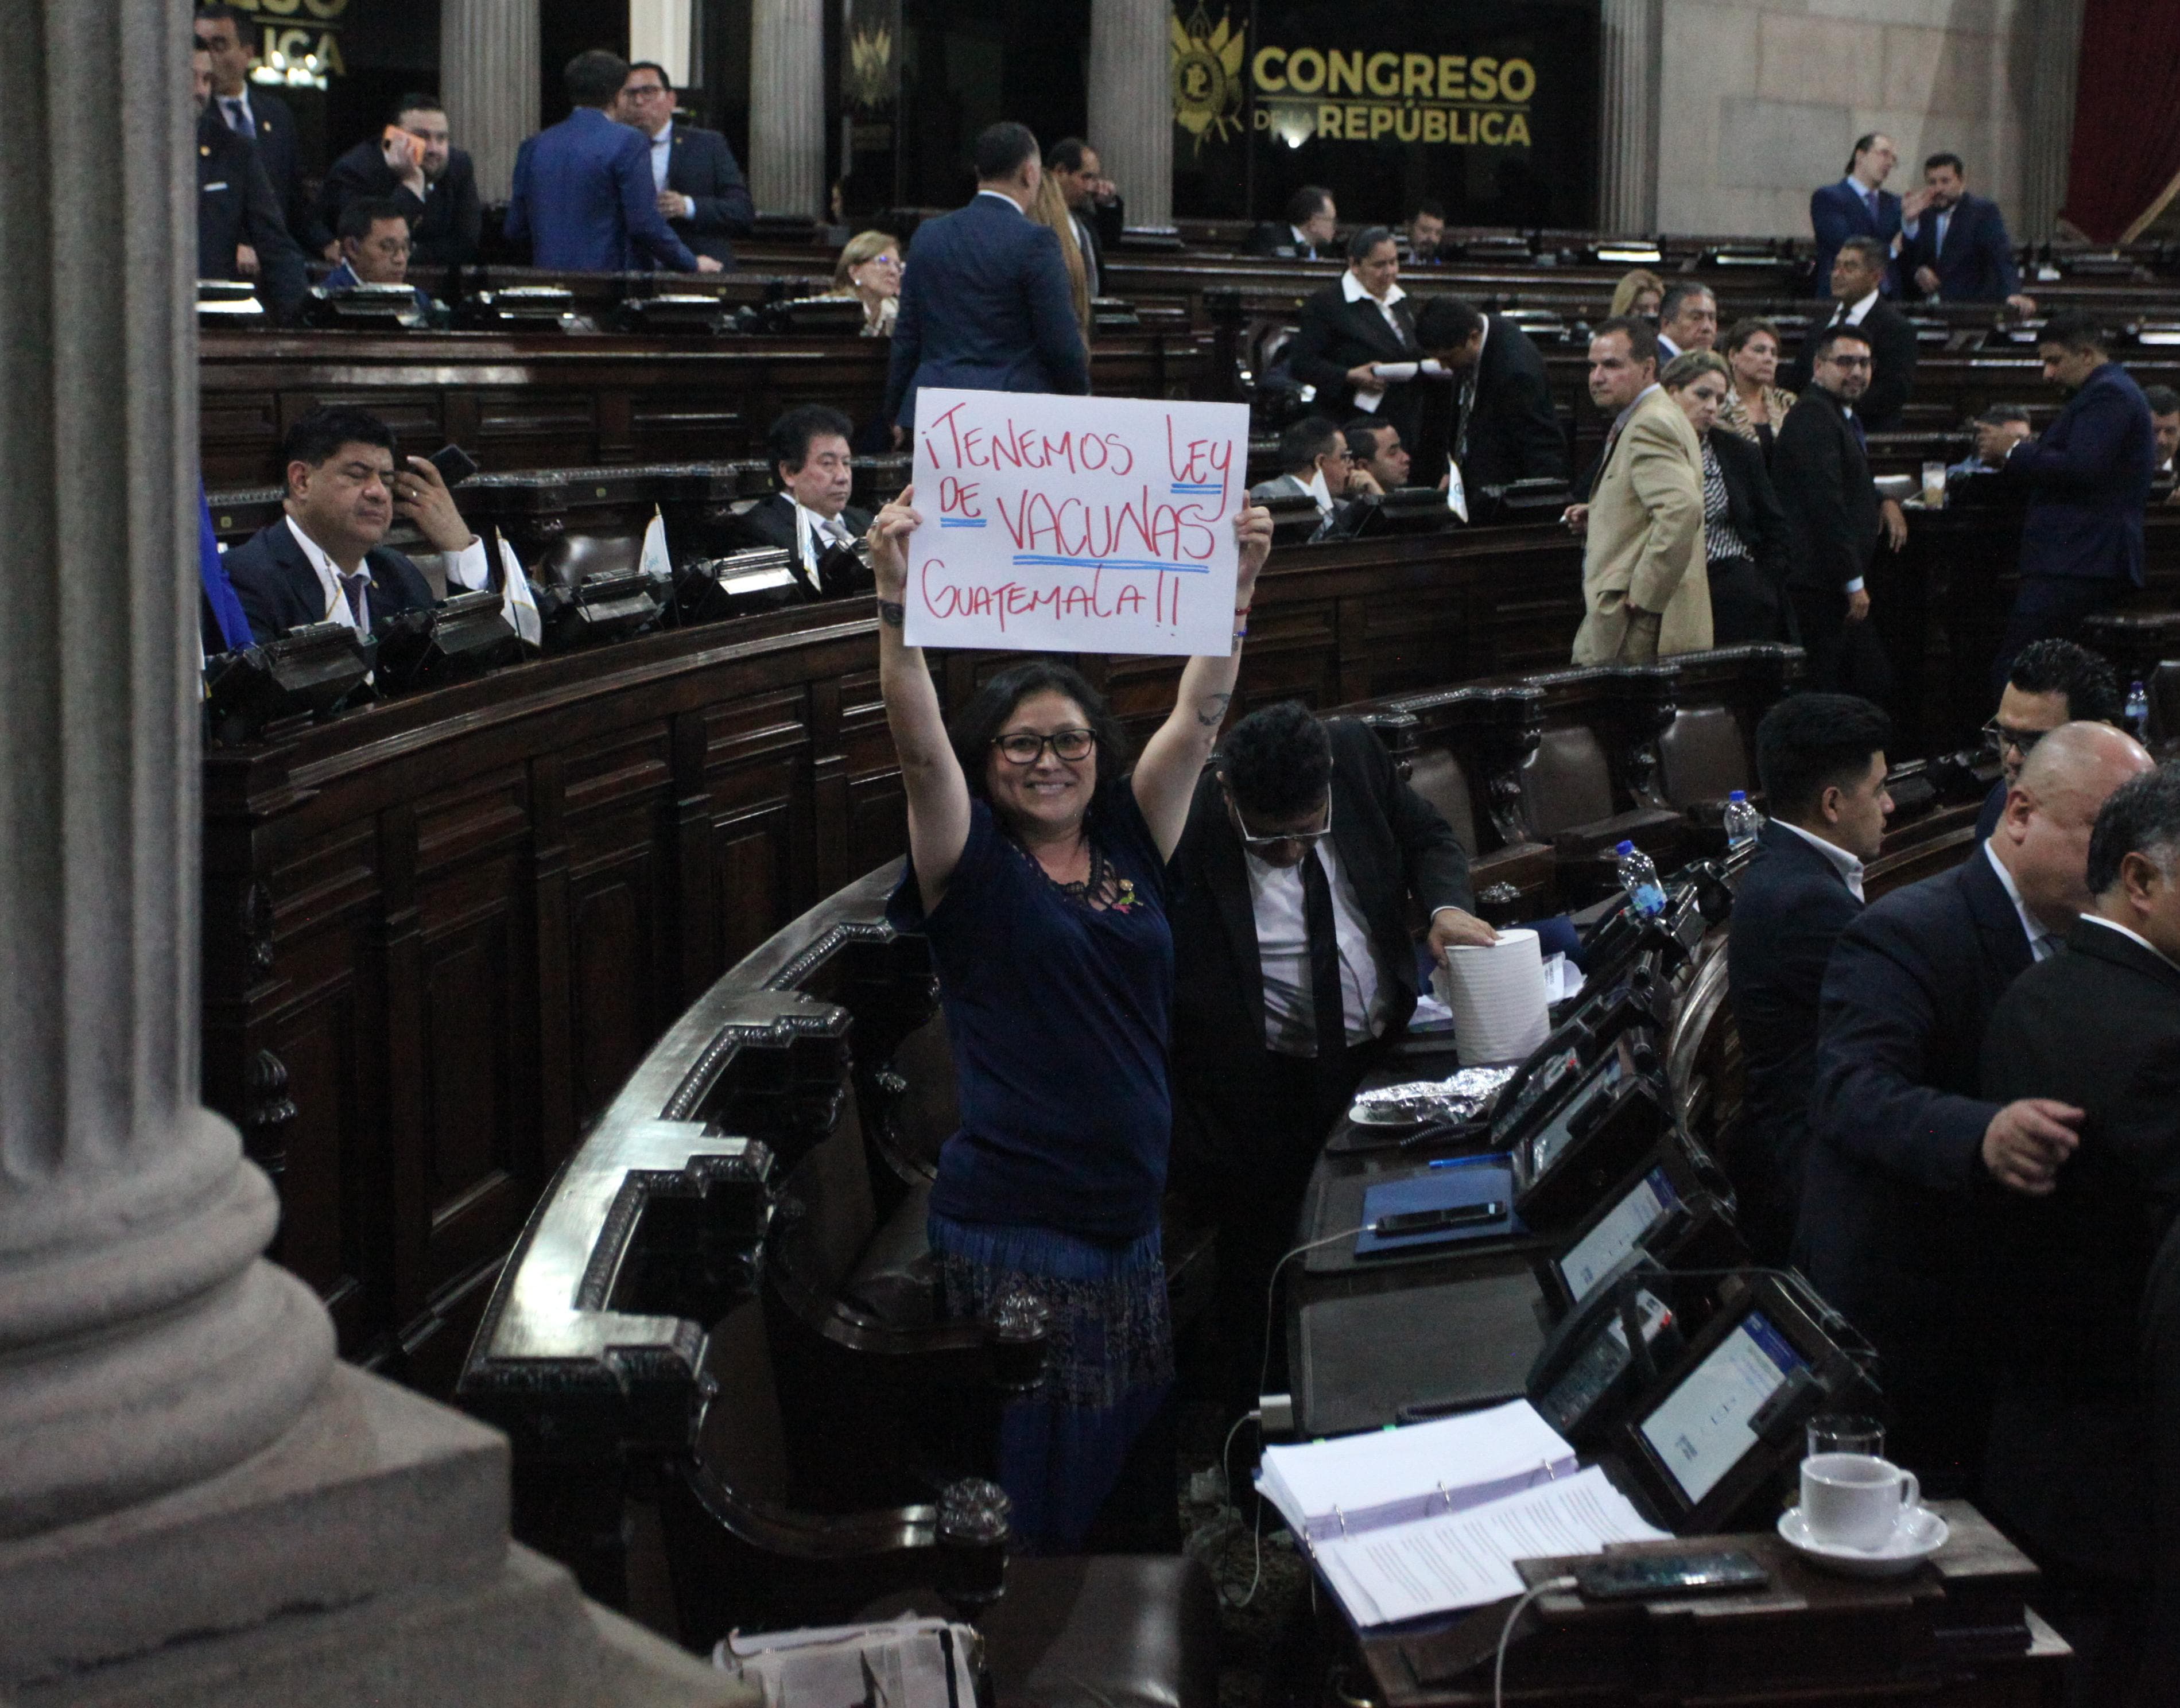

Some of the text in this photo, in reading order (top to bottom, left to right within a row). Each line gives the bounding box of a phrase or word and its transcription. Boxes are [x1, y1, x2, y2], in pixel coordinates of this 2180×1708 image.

[1252, 46, 1537, 102] CONGRESO
[1317, 99, 1531, 147] REPÚBLICA
[921, 403, 1133, 476] ¡TENEMOS
[940, 476, 1215, 560] DE VACUNAS
[922, 559, 1180, 636] GUATEMALA!!
